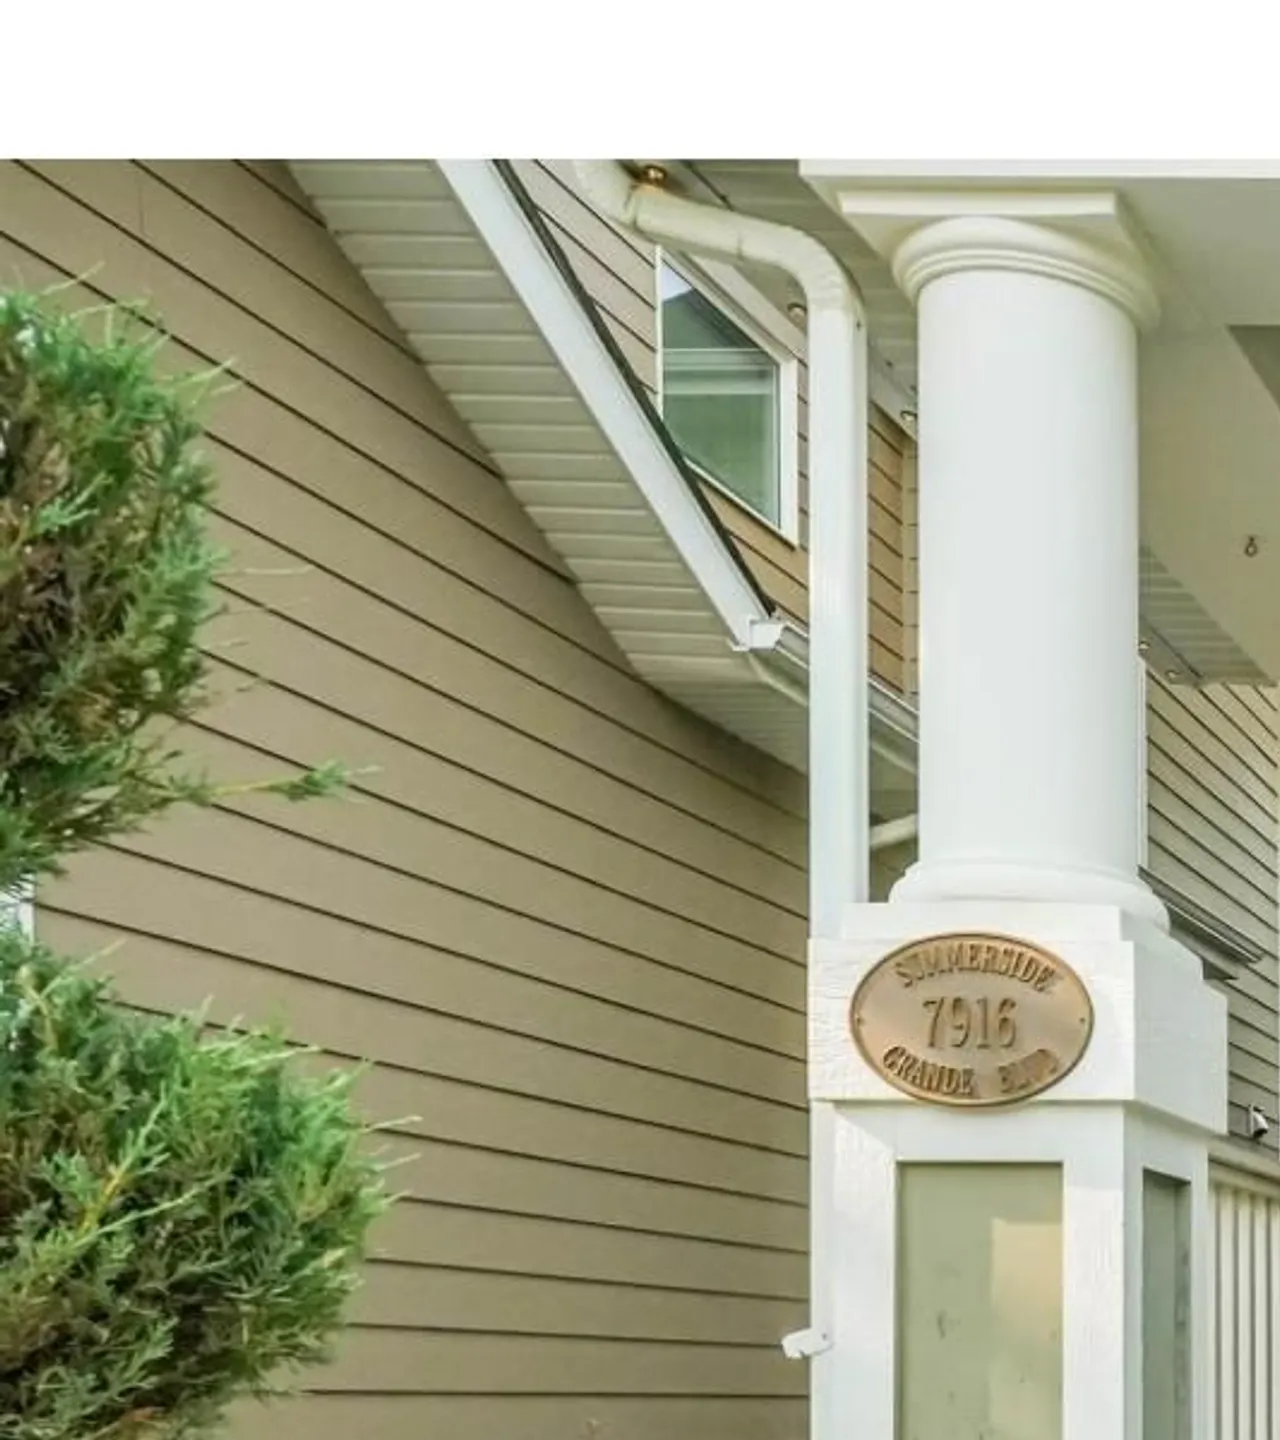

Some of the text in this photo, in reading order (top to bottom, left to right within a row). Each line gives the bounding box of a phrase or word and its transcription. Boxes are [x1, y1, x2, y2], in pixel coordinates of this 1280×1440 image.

[895, 942, 1056, 992] SUMMERSIDE
[923, 997, 1017, 1049] 7916
[882, 1046, 974, 1095] GRANDE
